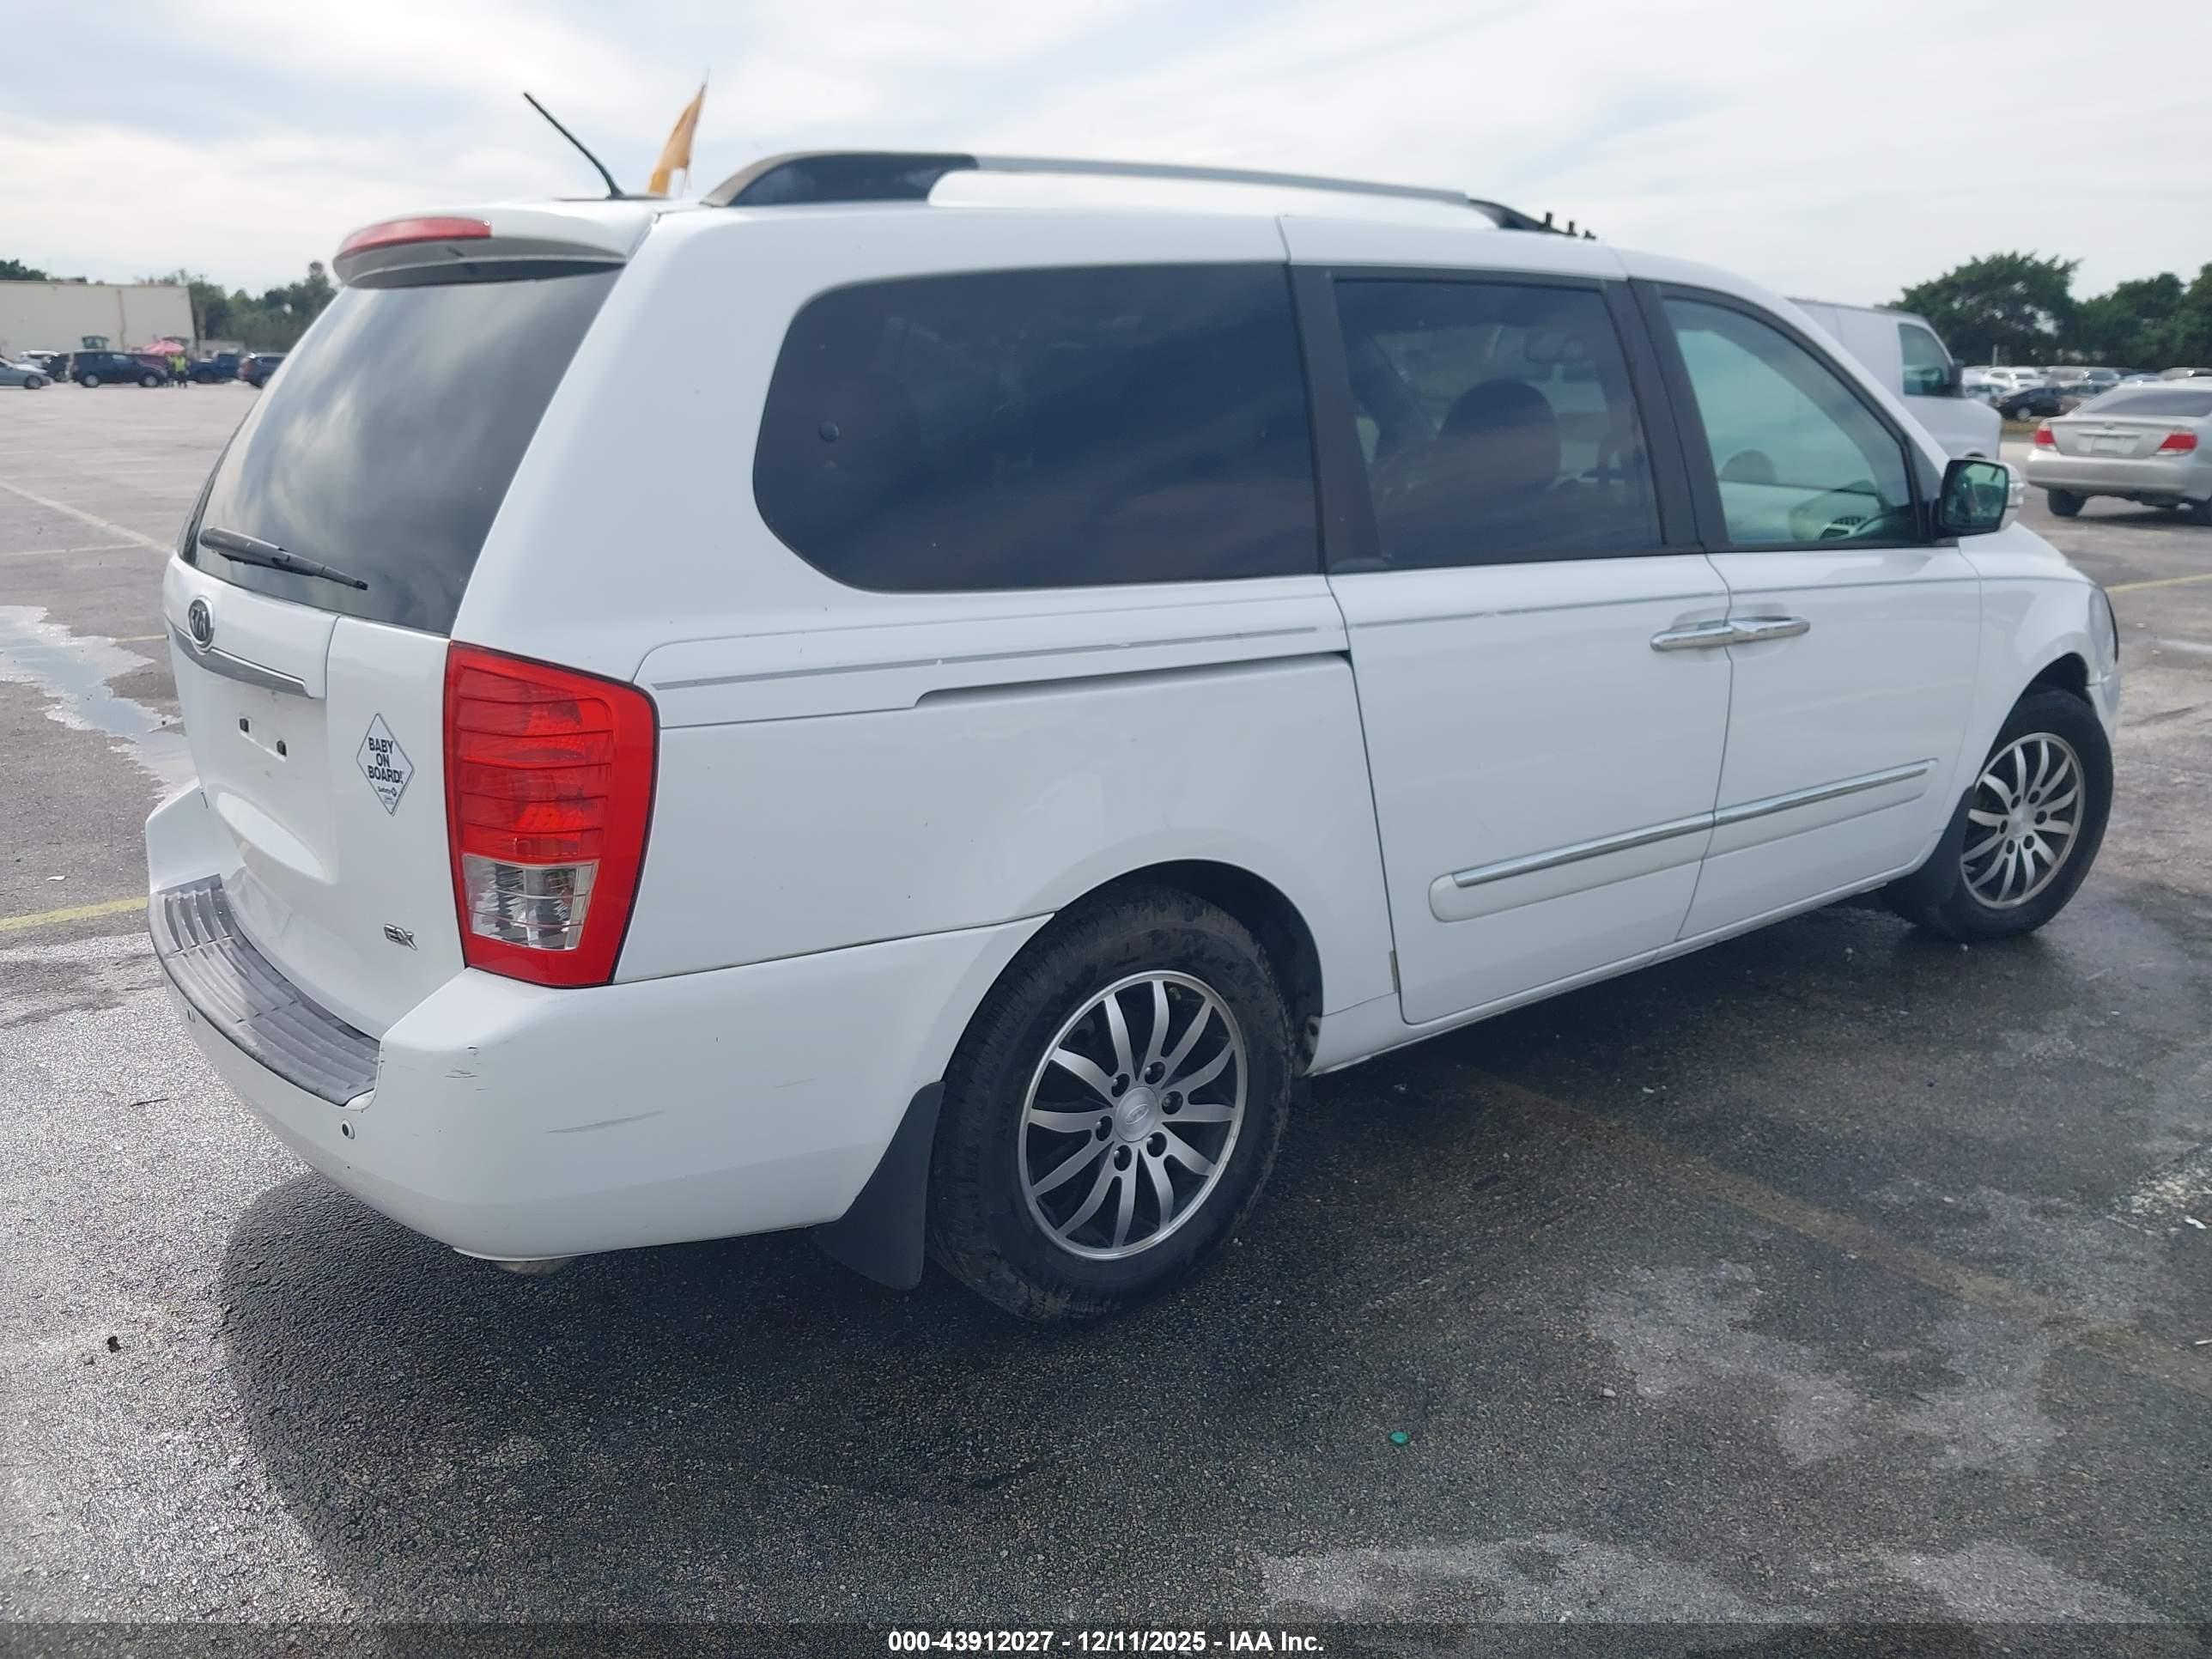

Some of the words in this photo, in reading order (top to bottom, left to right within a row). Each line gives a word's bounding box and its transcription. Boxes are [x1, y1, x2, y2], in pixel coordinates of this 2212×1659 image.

[368, 737, 394, 754] BABY
[375, 753, 391, 768] ON
[367, 764, 404, 785] BOARD!
[383, 923, 418, 951] EX
